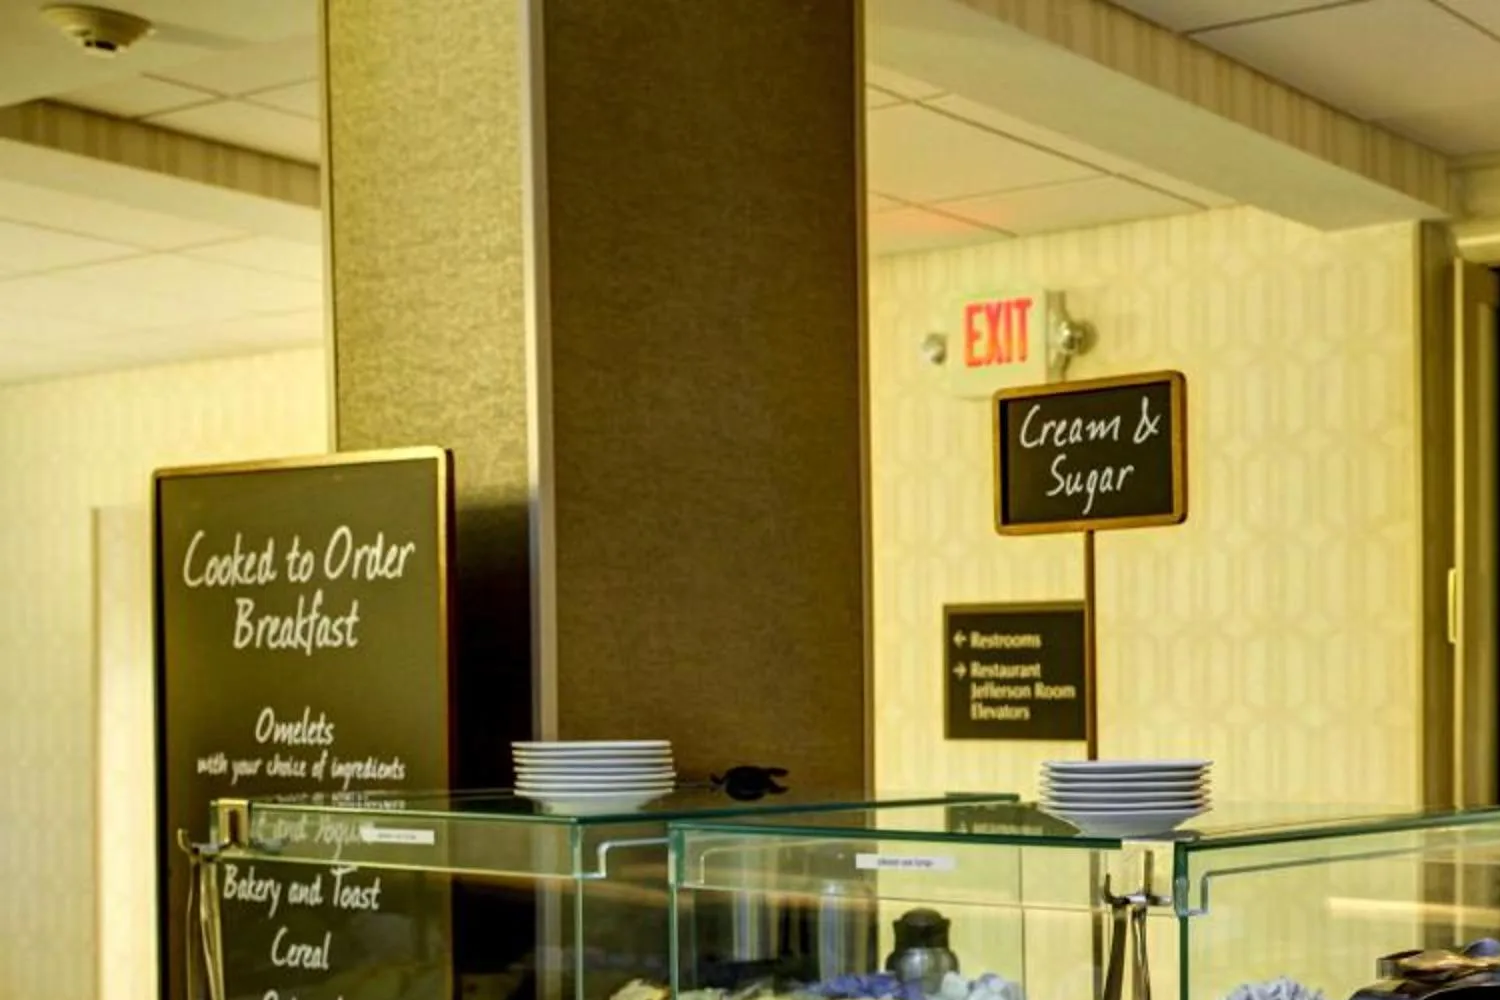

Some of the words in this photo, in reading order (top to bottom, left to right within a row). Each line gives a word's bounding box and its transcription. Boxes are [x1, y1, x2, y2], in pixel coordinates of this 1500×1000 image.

[964, 297, 1033, 368] EXIT
[1019, 403, 1122, 448] Cream
[1133, 396, 1161, 445] &
[1046, 453, 1135, 515] Sugar
[183, 530, 277, 587] Cooked
[286, 534, 314, 583] to
[324, 525, 416, 580] Order
[233, 588, 360, 657] Breakfast
[970, 631, 1041, 649] Restrooms
[970, 661, 1041, 678] Restaurant
[1034, 682, 1076, 699] Room
[255, 706, 335, 745] Omelets
[970, 702, 1031, 720] Elevators
[197, 752, 227, 775] with
[231, 757, 262, 785] your
[266, 753, 306, 778] choice
[311, 749, 328, 781] of
[331, 756, 405, 790] ingredients
[223, 864, 281, 918] Bakery
[288, 876, 322, 907] and
[330, 864, 382, 911] Toast
[271, 926, 331, 971] Cereal
